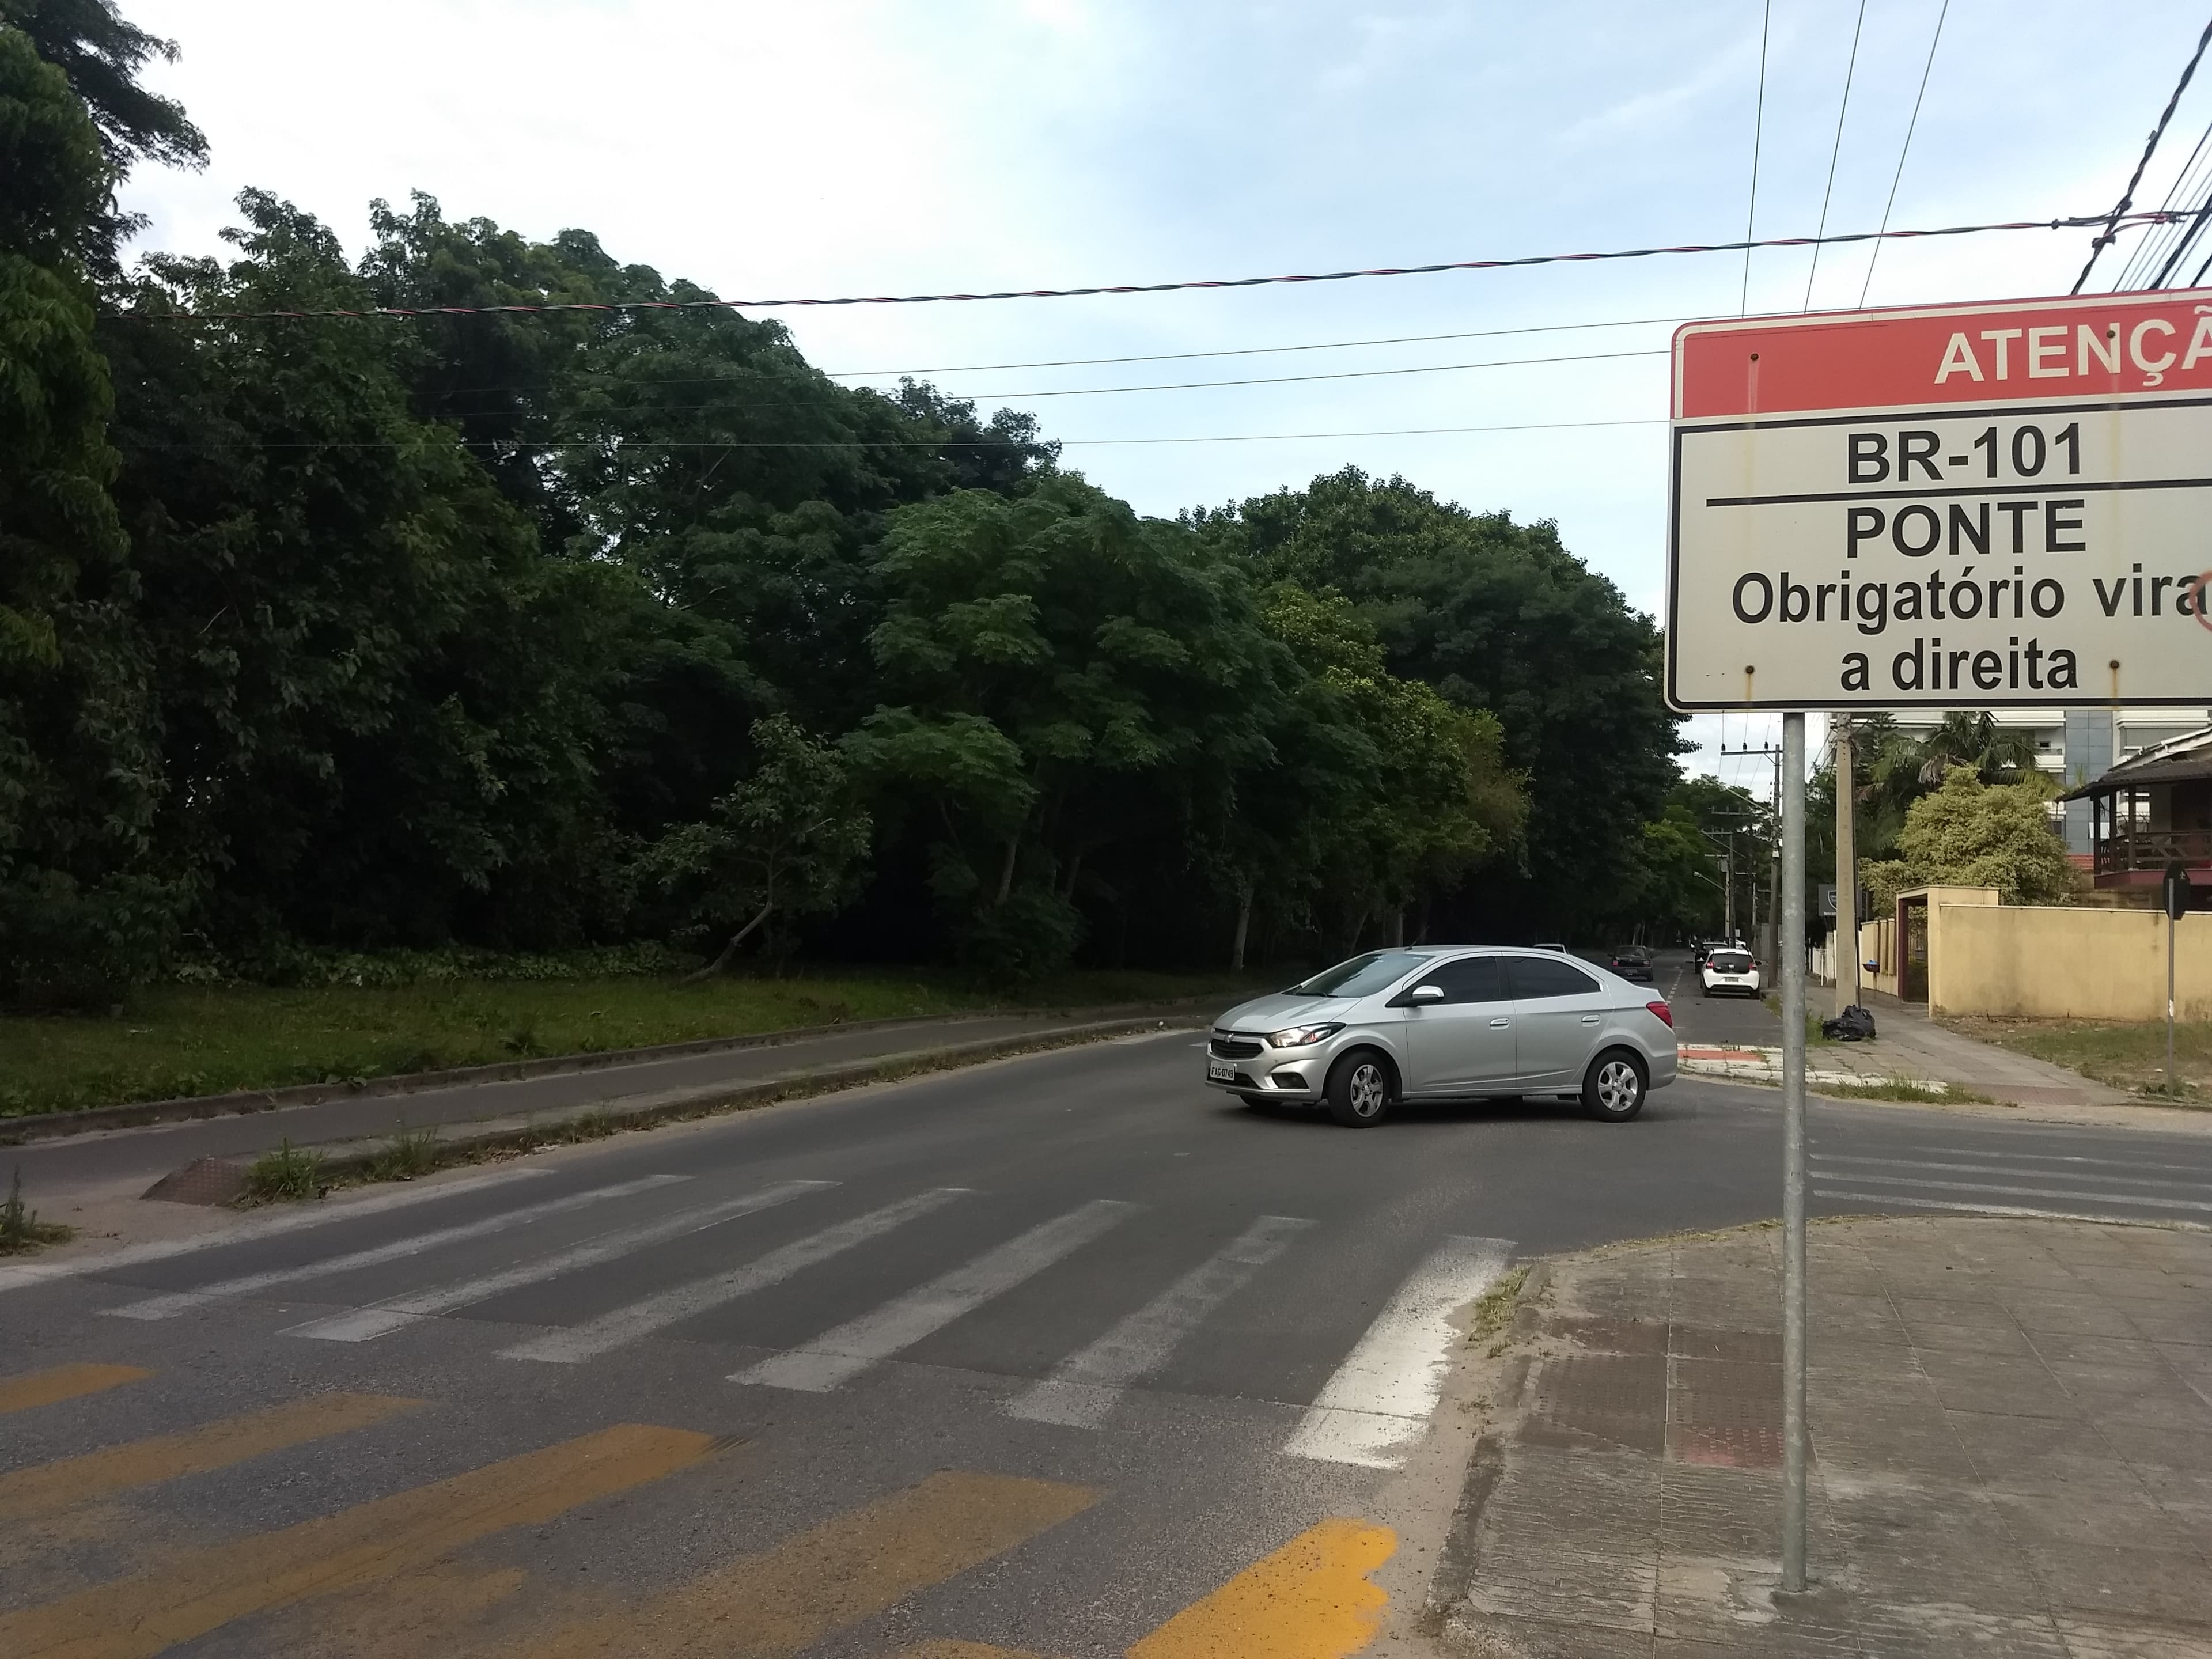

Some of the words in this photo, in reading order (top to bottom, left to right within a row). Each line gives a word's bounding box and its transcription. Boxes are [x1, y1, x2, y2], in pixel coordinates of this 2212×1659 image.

[1848, 422, 2080, 484] BR-101
[1847, 499, 2086, 559] PONTE
[1732, 565, 2065, 635] Obrigatório
[1840, 652, 1871, 691] a
[1892, 636, 2078, 691] direita
